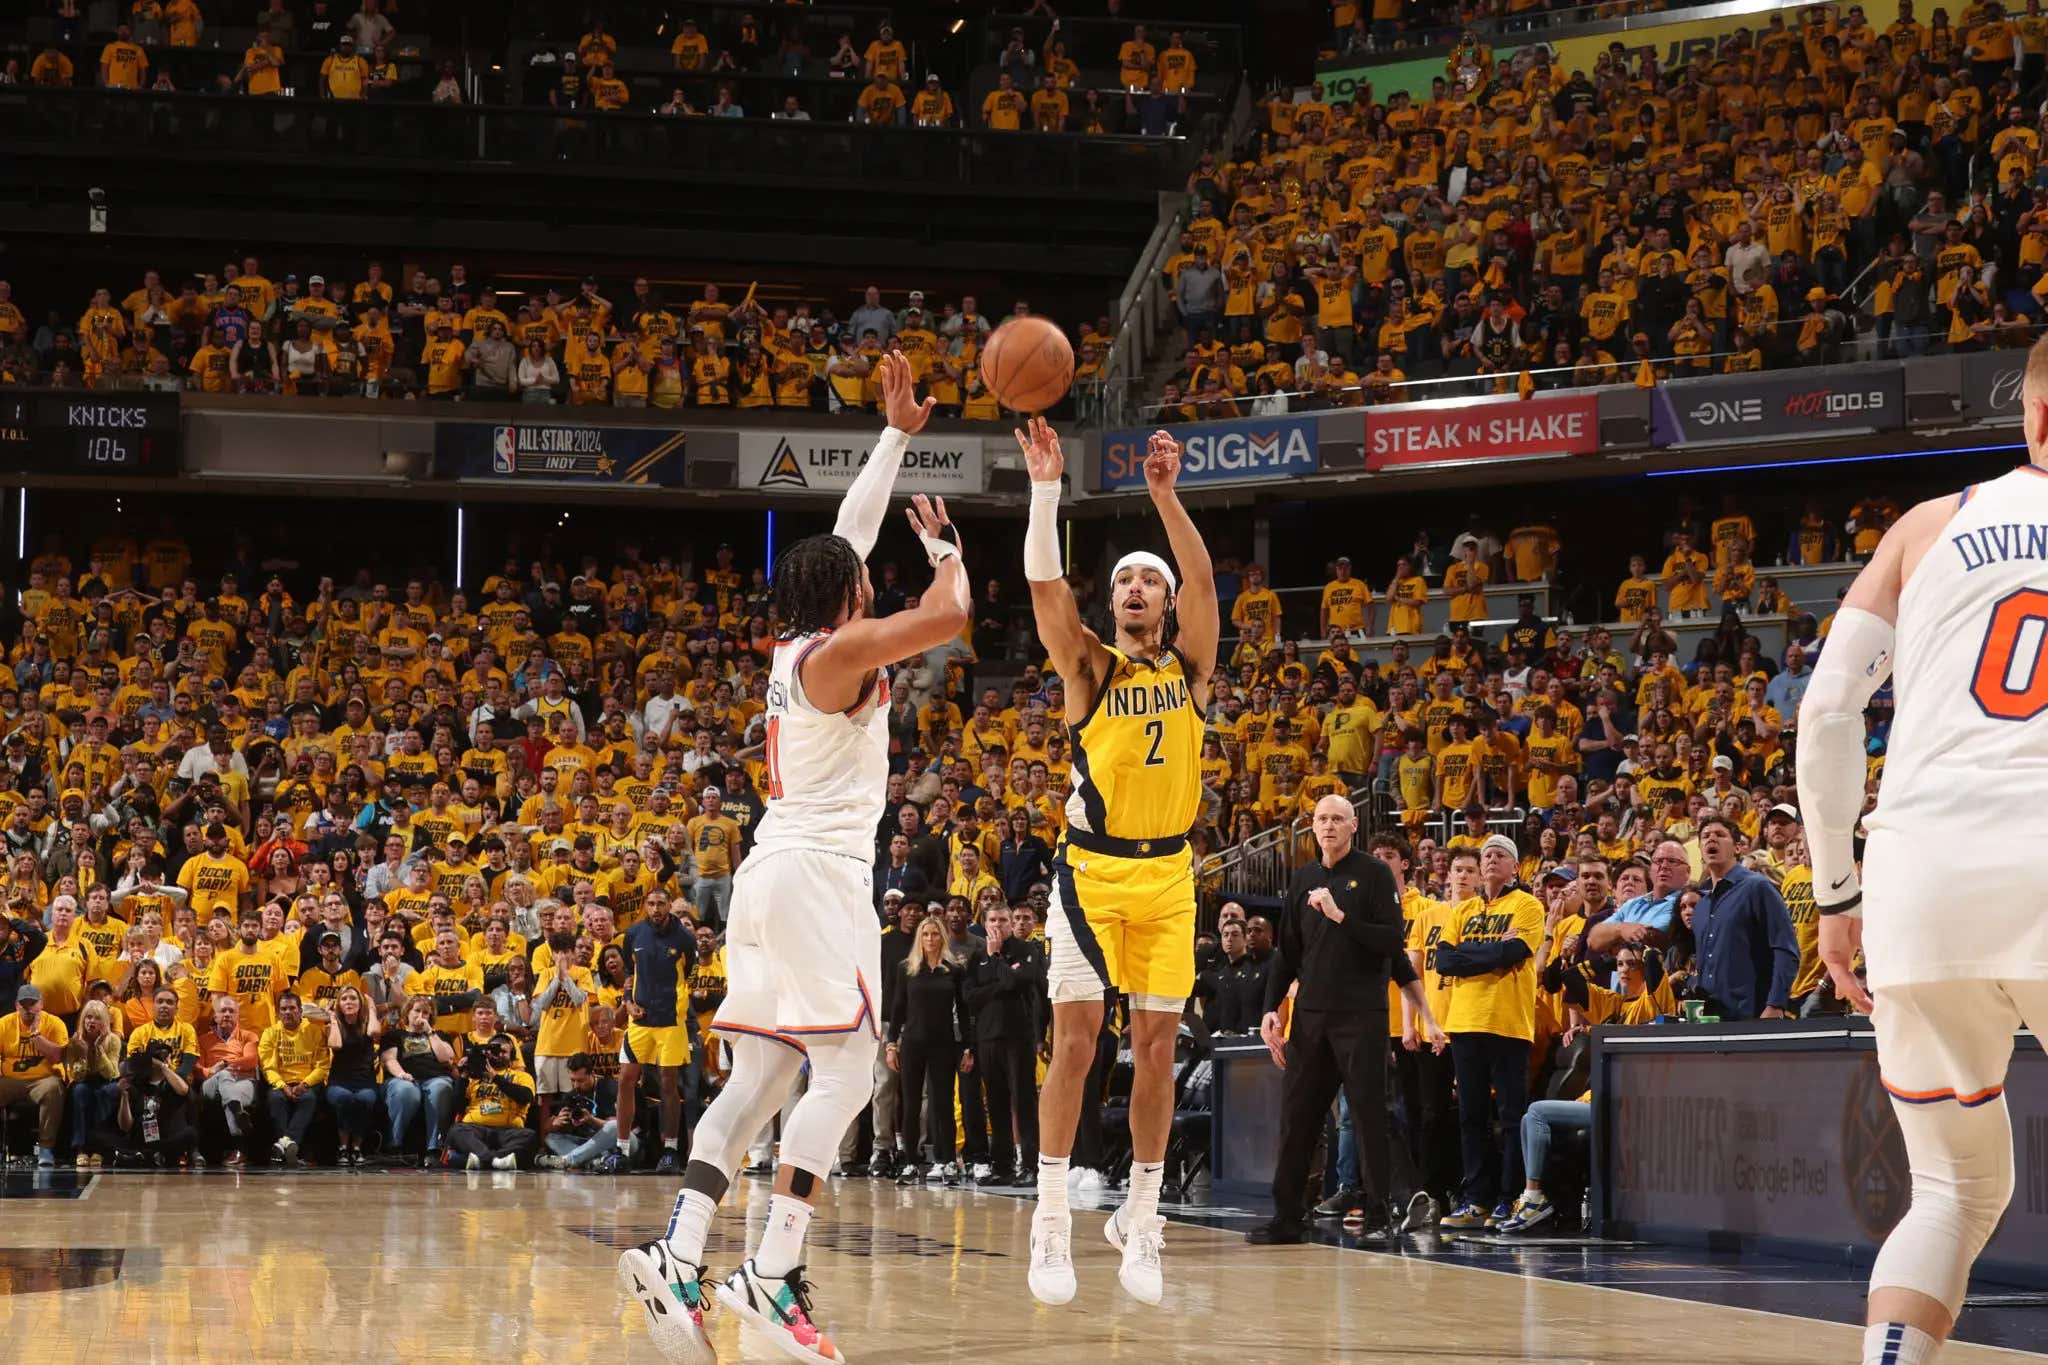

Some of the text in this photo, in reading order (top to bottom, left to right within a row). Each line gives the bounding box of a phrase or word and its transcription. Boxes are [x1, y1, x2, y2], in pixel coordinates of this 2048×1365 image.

[1826, 391, 1884, 412] 100.9
[68, 405, 147, 428] KNICKS
[574, 430, 602, 452] 2024
[1374, 413, 1583, 454] STEAK N SHAKE
[87, 437, 126, 462] 106
[809, 449, 963, 469] LIFT ADEMY
[1107, 429, 1312, 479] SHSIGMA
[546, 456, 577, 469] INDY
[1106, 678, 1189, 717] INDIANA
[1144, 720, 1166, 767] 2
[198, 867, 233, 878] BOOM
[196, 878, 232, 891] BABY!
[236, 965, 272, 978] BOOM
[237, 978, 271, 993] BABY!
[434, 979, 468, 991] BOOM
[1734, 1154, 1828, 1203] Google Pixel
